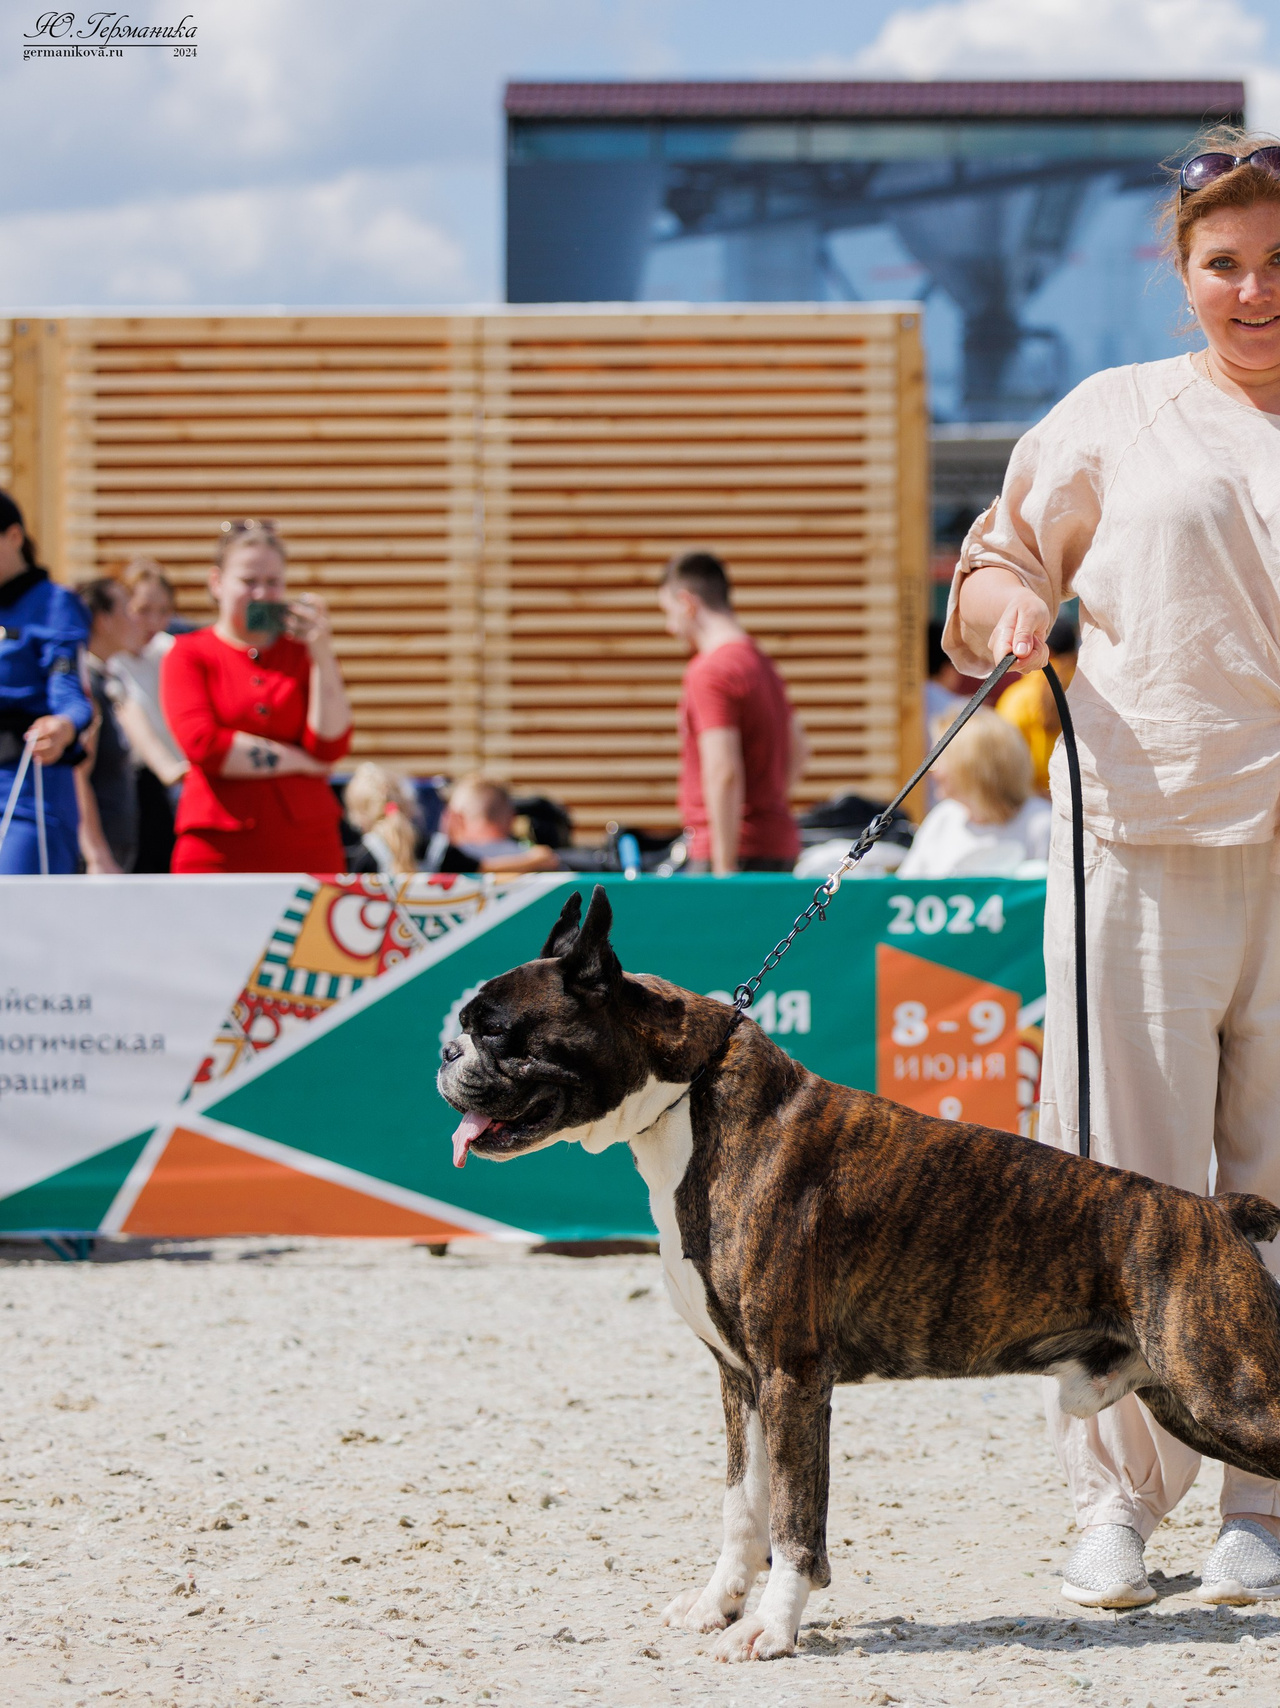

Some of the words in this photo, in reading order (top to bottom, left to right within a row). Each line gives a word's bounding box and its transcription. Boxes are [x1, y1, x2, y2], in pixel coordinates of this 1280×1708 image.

[887, 894, 1005, 935] 2024
[0, 986, 92, 1014] йская
[893, 1053, 1006, 1081] ИЮНЯ
